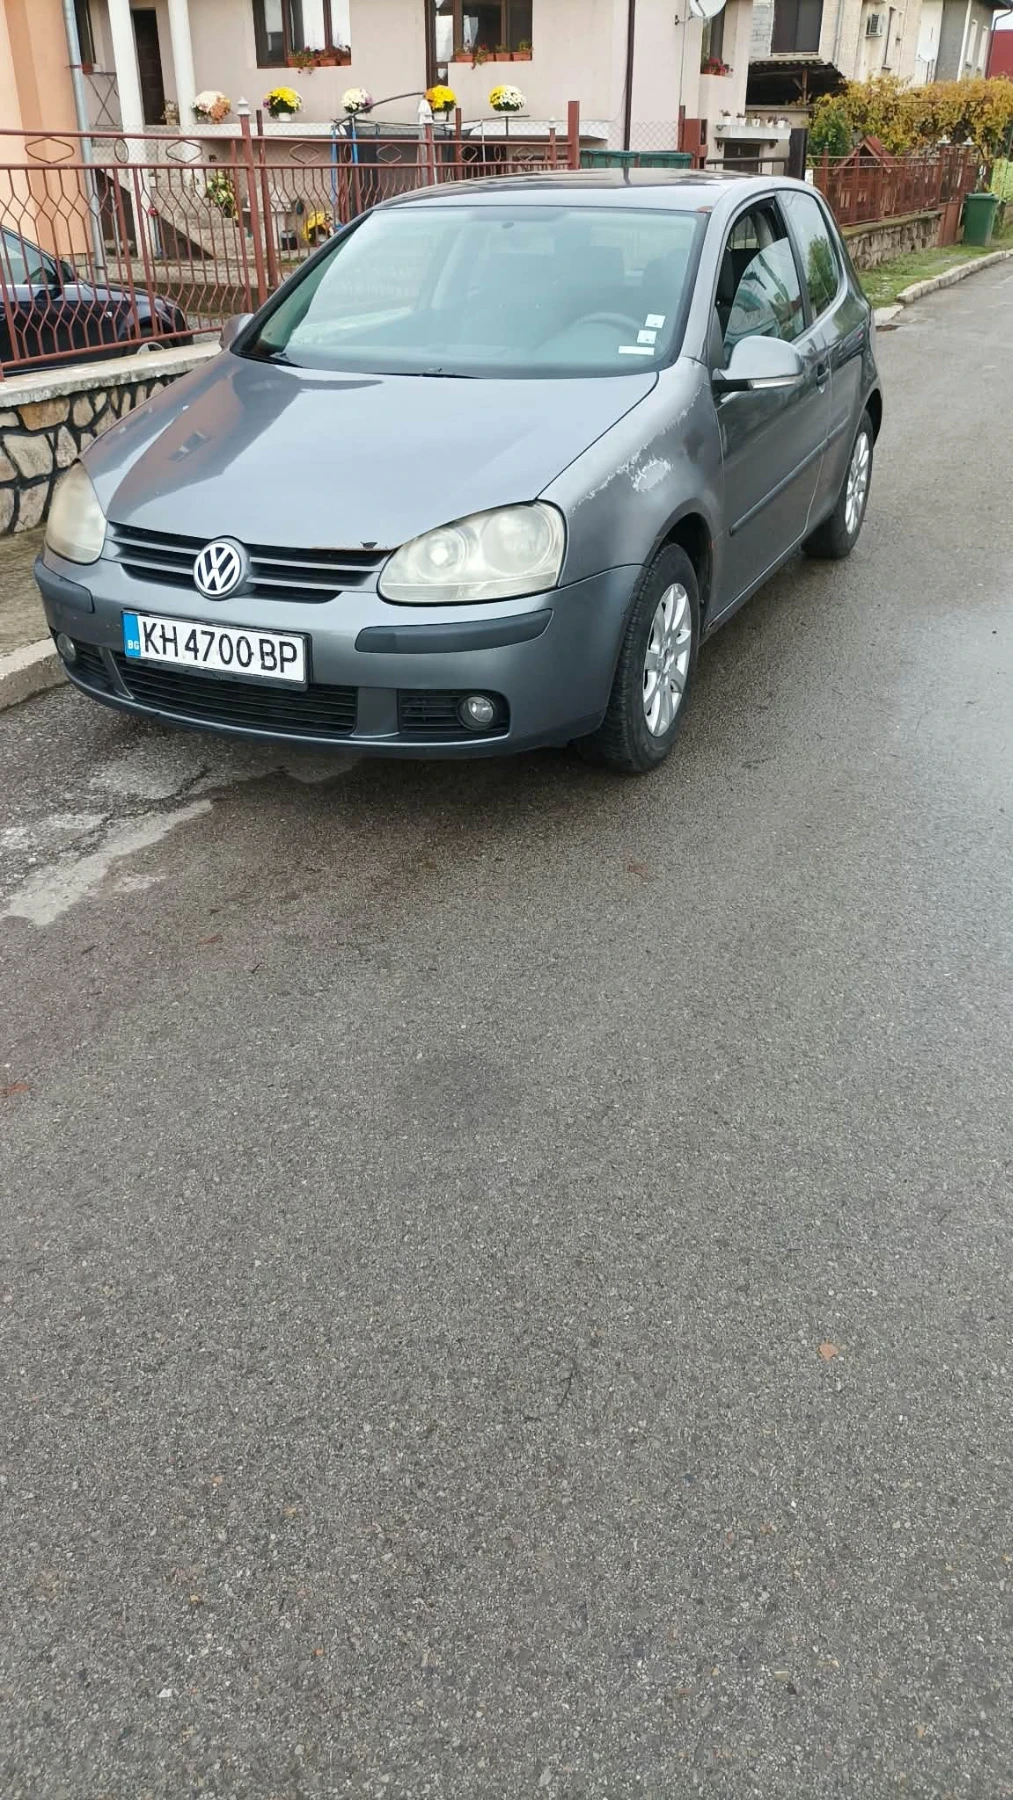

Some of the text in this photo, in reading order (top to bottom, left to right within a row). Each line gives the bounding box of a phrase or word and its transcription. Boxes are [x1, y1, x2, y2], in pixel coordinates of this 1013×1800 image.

[196, 544, 239, 593] VW
[127, 640, 140, 650] BG
[143, 621, 297, 673] KH 4700 BP
